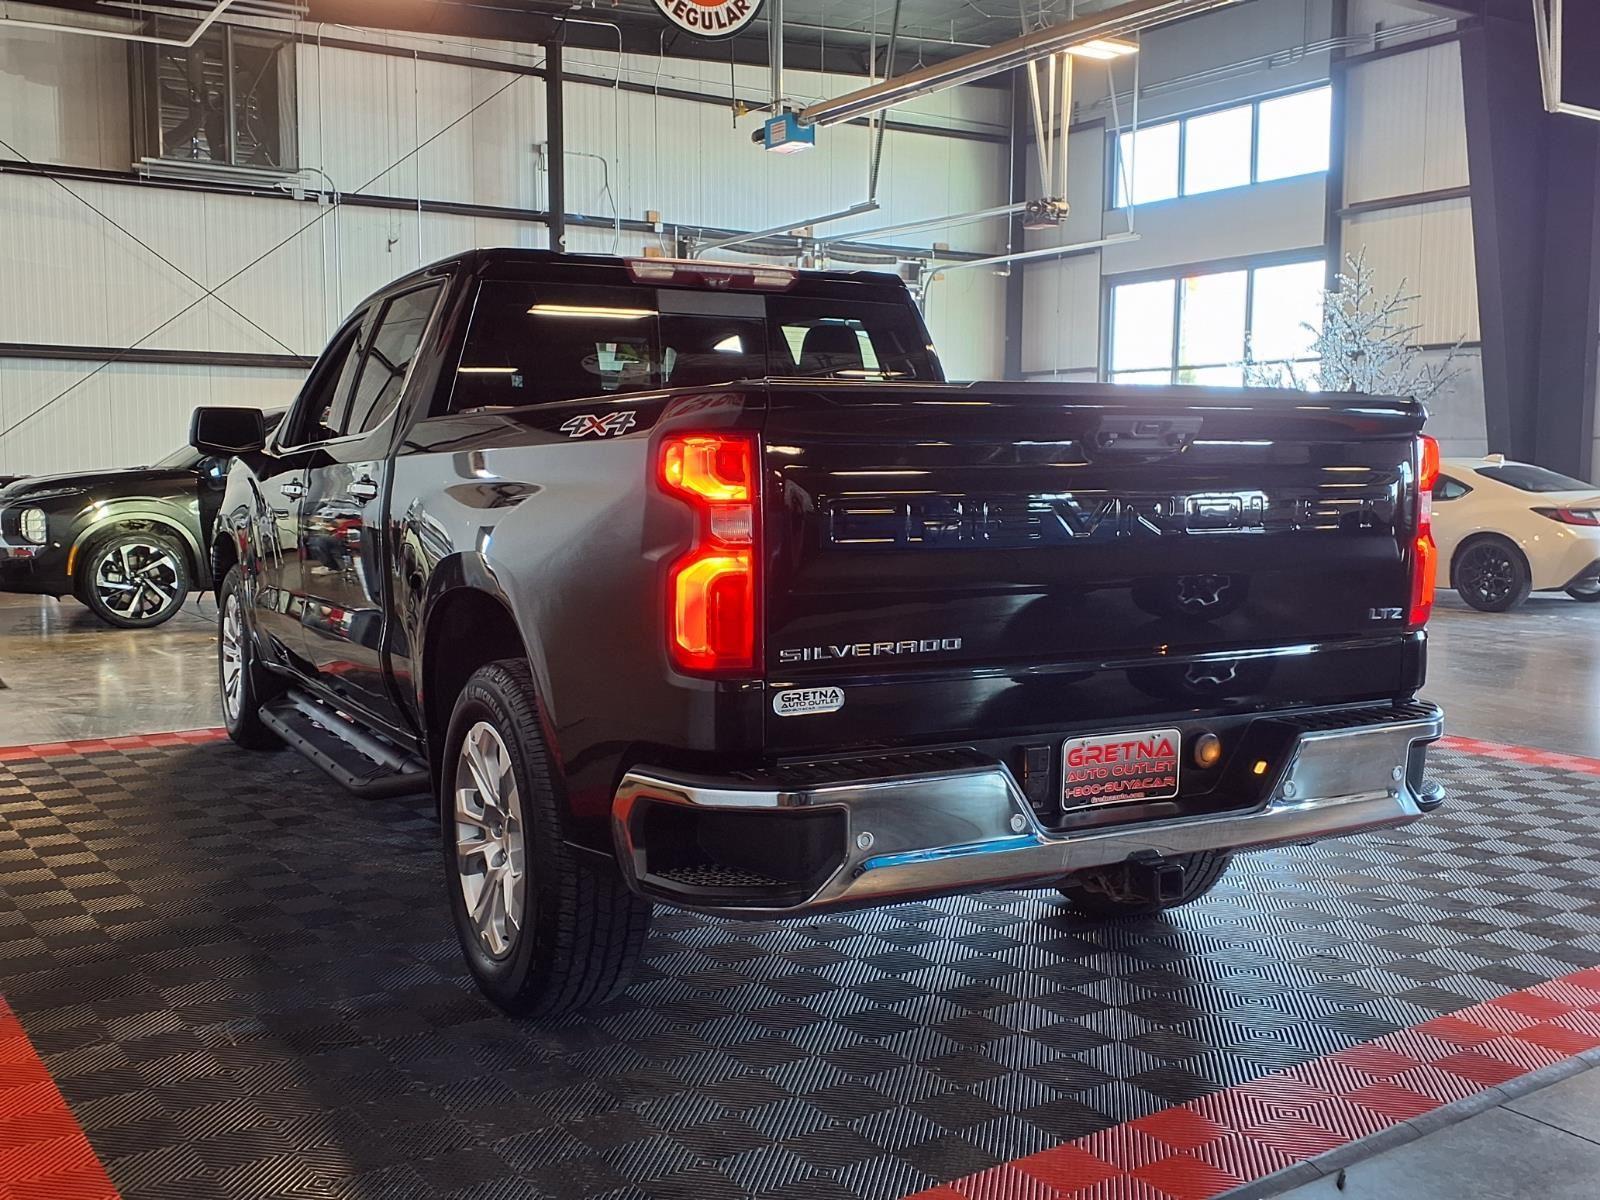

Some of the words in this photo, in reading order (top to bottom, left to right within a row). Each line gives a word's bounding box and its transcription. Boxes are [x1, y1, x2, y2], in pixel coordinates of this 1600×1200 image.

[1369, 607, 1403, 620] LTZ
[779, 637, 962, 663] SILVERADO
[781, 689, 839, 703] GRETNA
[781, 701, 806, 709] AUTO
[808, 697, 840, 706] OUTLET
[1067, 737, 1175, 767] GRETNA
[1065, 767, 1108, 783] AUTO
[1112, 760, 1176, 776] OUTLET
[1064, 776, 1175, 799] 1-800-BUYACAR
